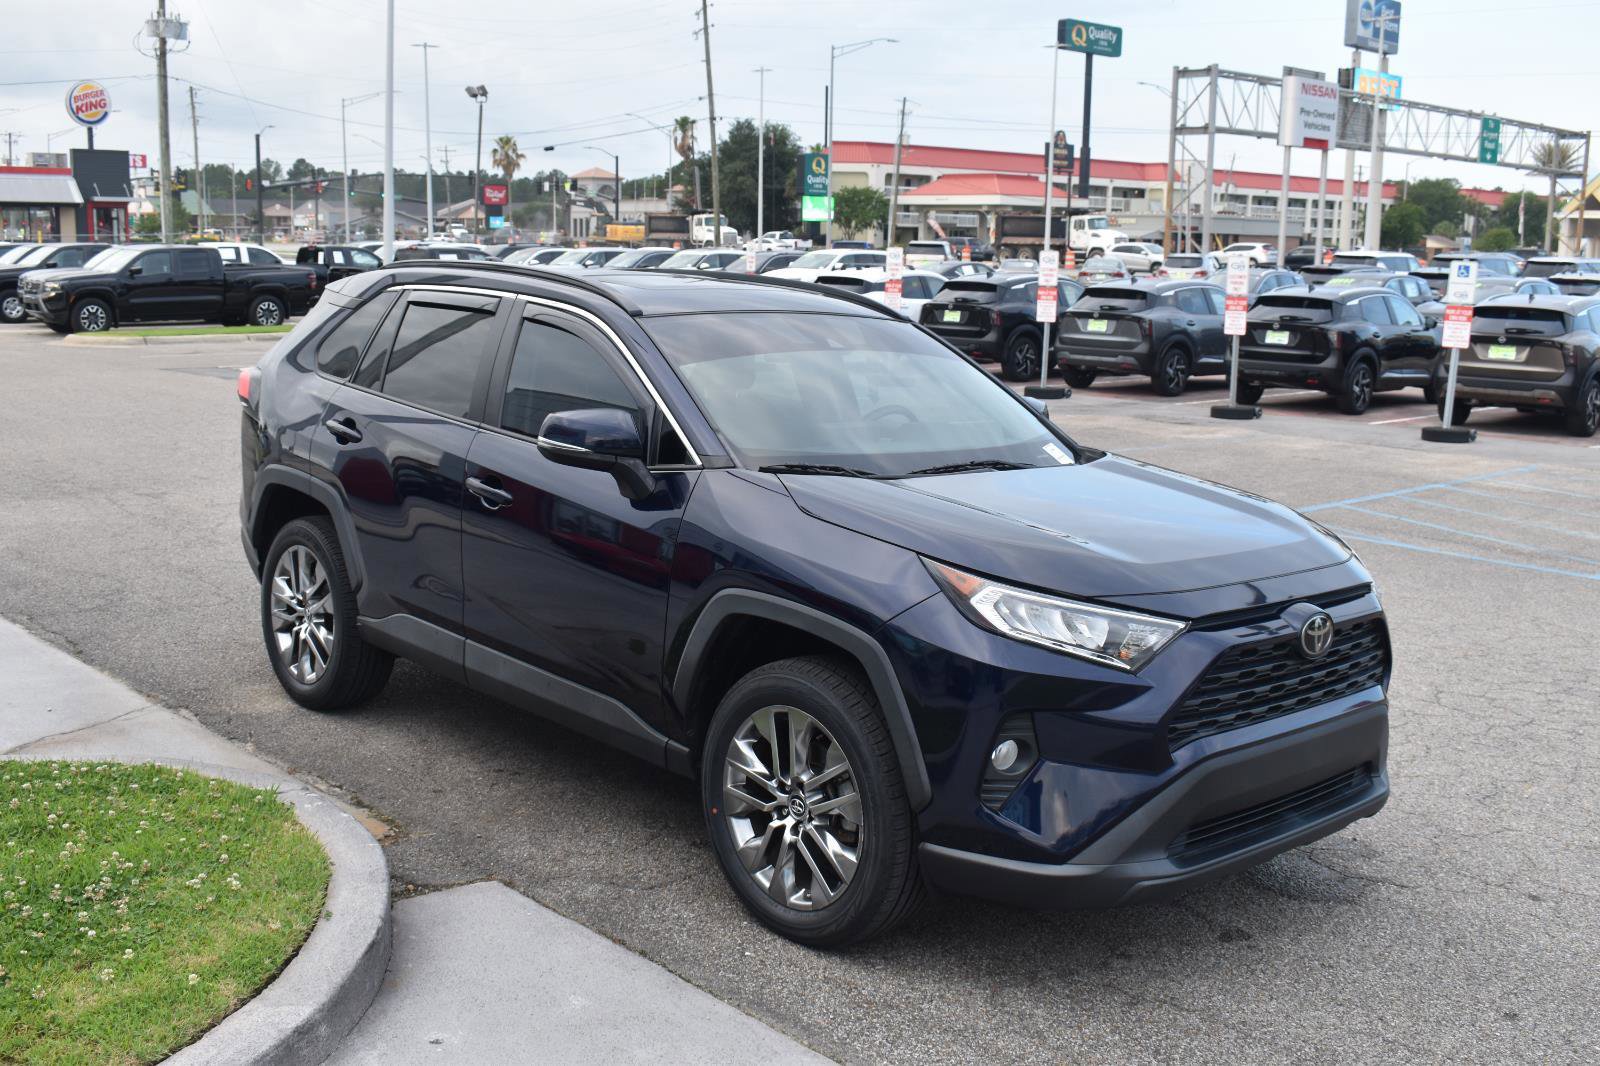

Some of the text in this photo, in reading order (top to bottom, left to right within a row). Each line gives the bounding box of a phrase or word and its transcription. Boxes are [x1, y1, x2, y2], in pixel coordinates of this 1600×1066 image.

[1072, 24, 1118, 47] Q Quality
[74, 89, 105, 104] BURGER
[1301, 83, 1337, 99] NISSAN
[76, 98, 107, 114] KING
[1300, 107, 1335, 120] Pre-Owned
[1304, 121, 1331, 132] Vehicles
[812, 157, 826, 175] Q
[807, 174, 830, 185] Quality
